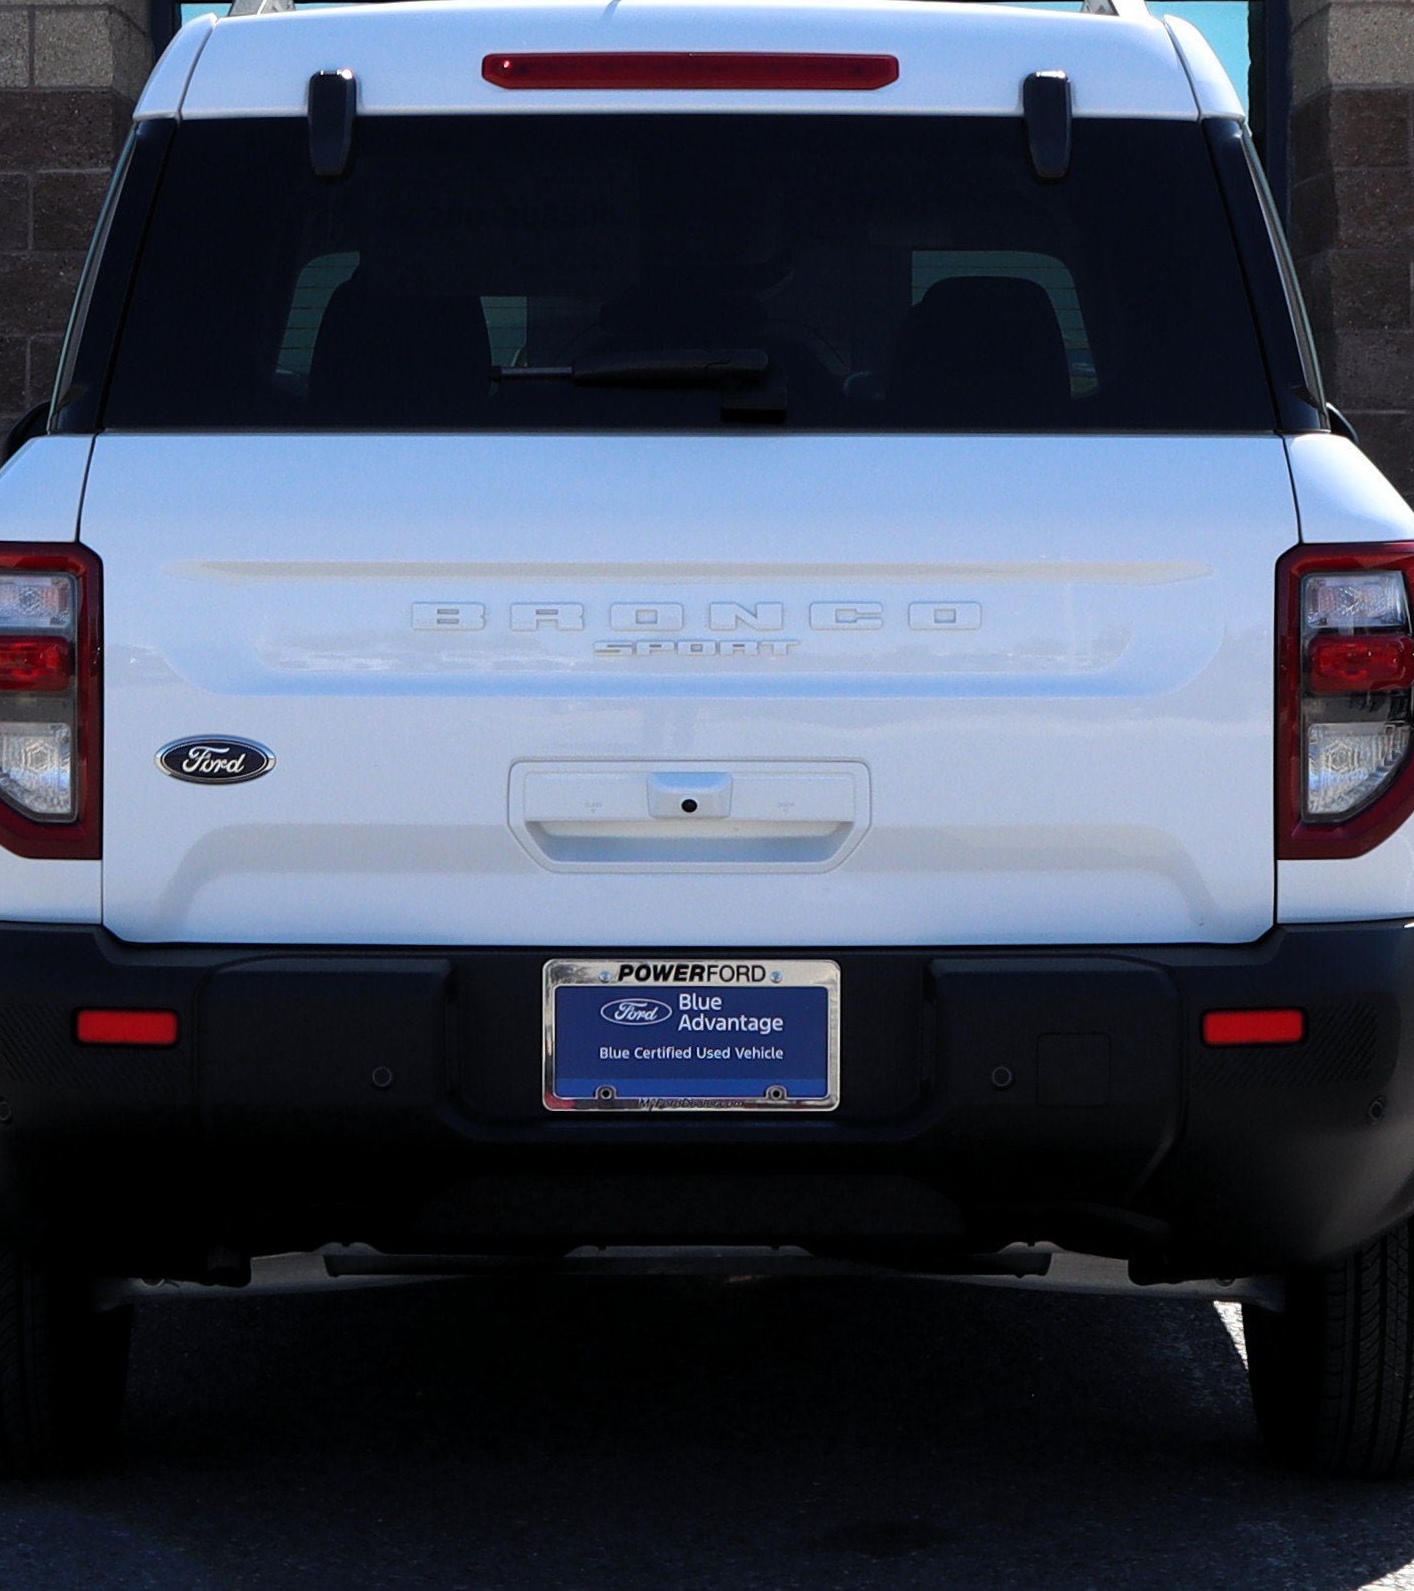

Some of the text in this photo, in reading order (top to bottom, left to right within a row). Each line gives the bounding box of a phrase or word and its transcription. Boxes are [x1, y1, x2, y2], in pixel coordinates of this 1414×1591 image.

[411, 600, 983, 633] BRONCO
[593, 639, 802, 657] SPORT
[182, 745, 247, 774] Ford
[617, 963, 767, 983] POWERFORD
[614, 1000, 659, 1022] Ford
[678, 993, 723, 1011] Blue
[678, 1014, 784, 1035] Advantage
[599, 1046, 784, 1060] Blue Certified Used Vehicle
